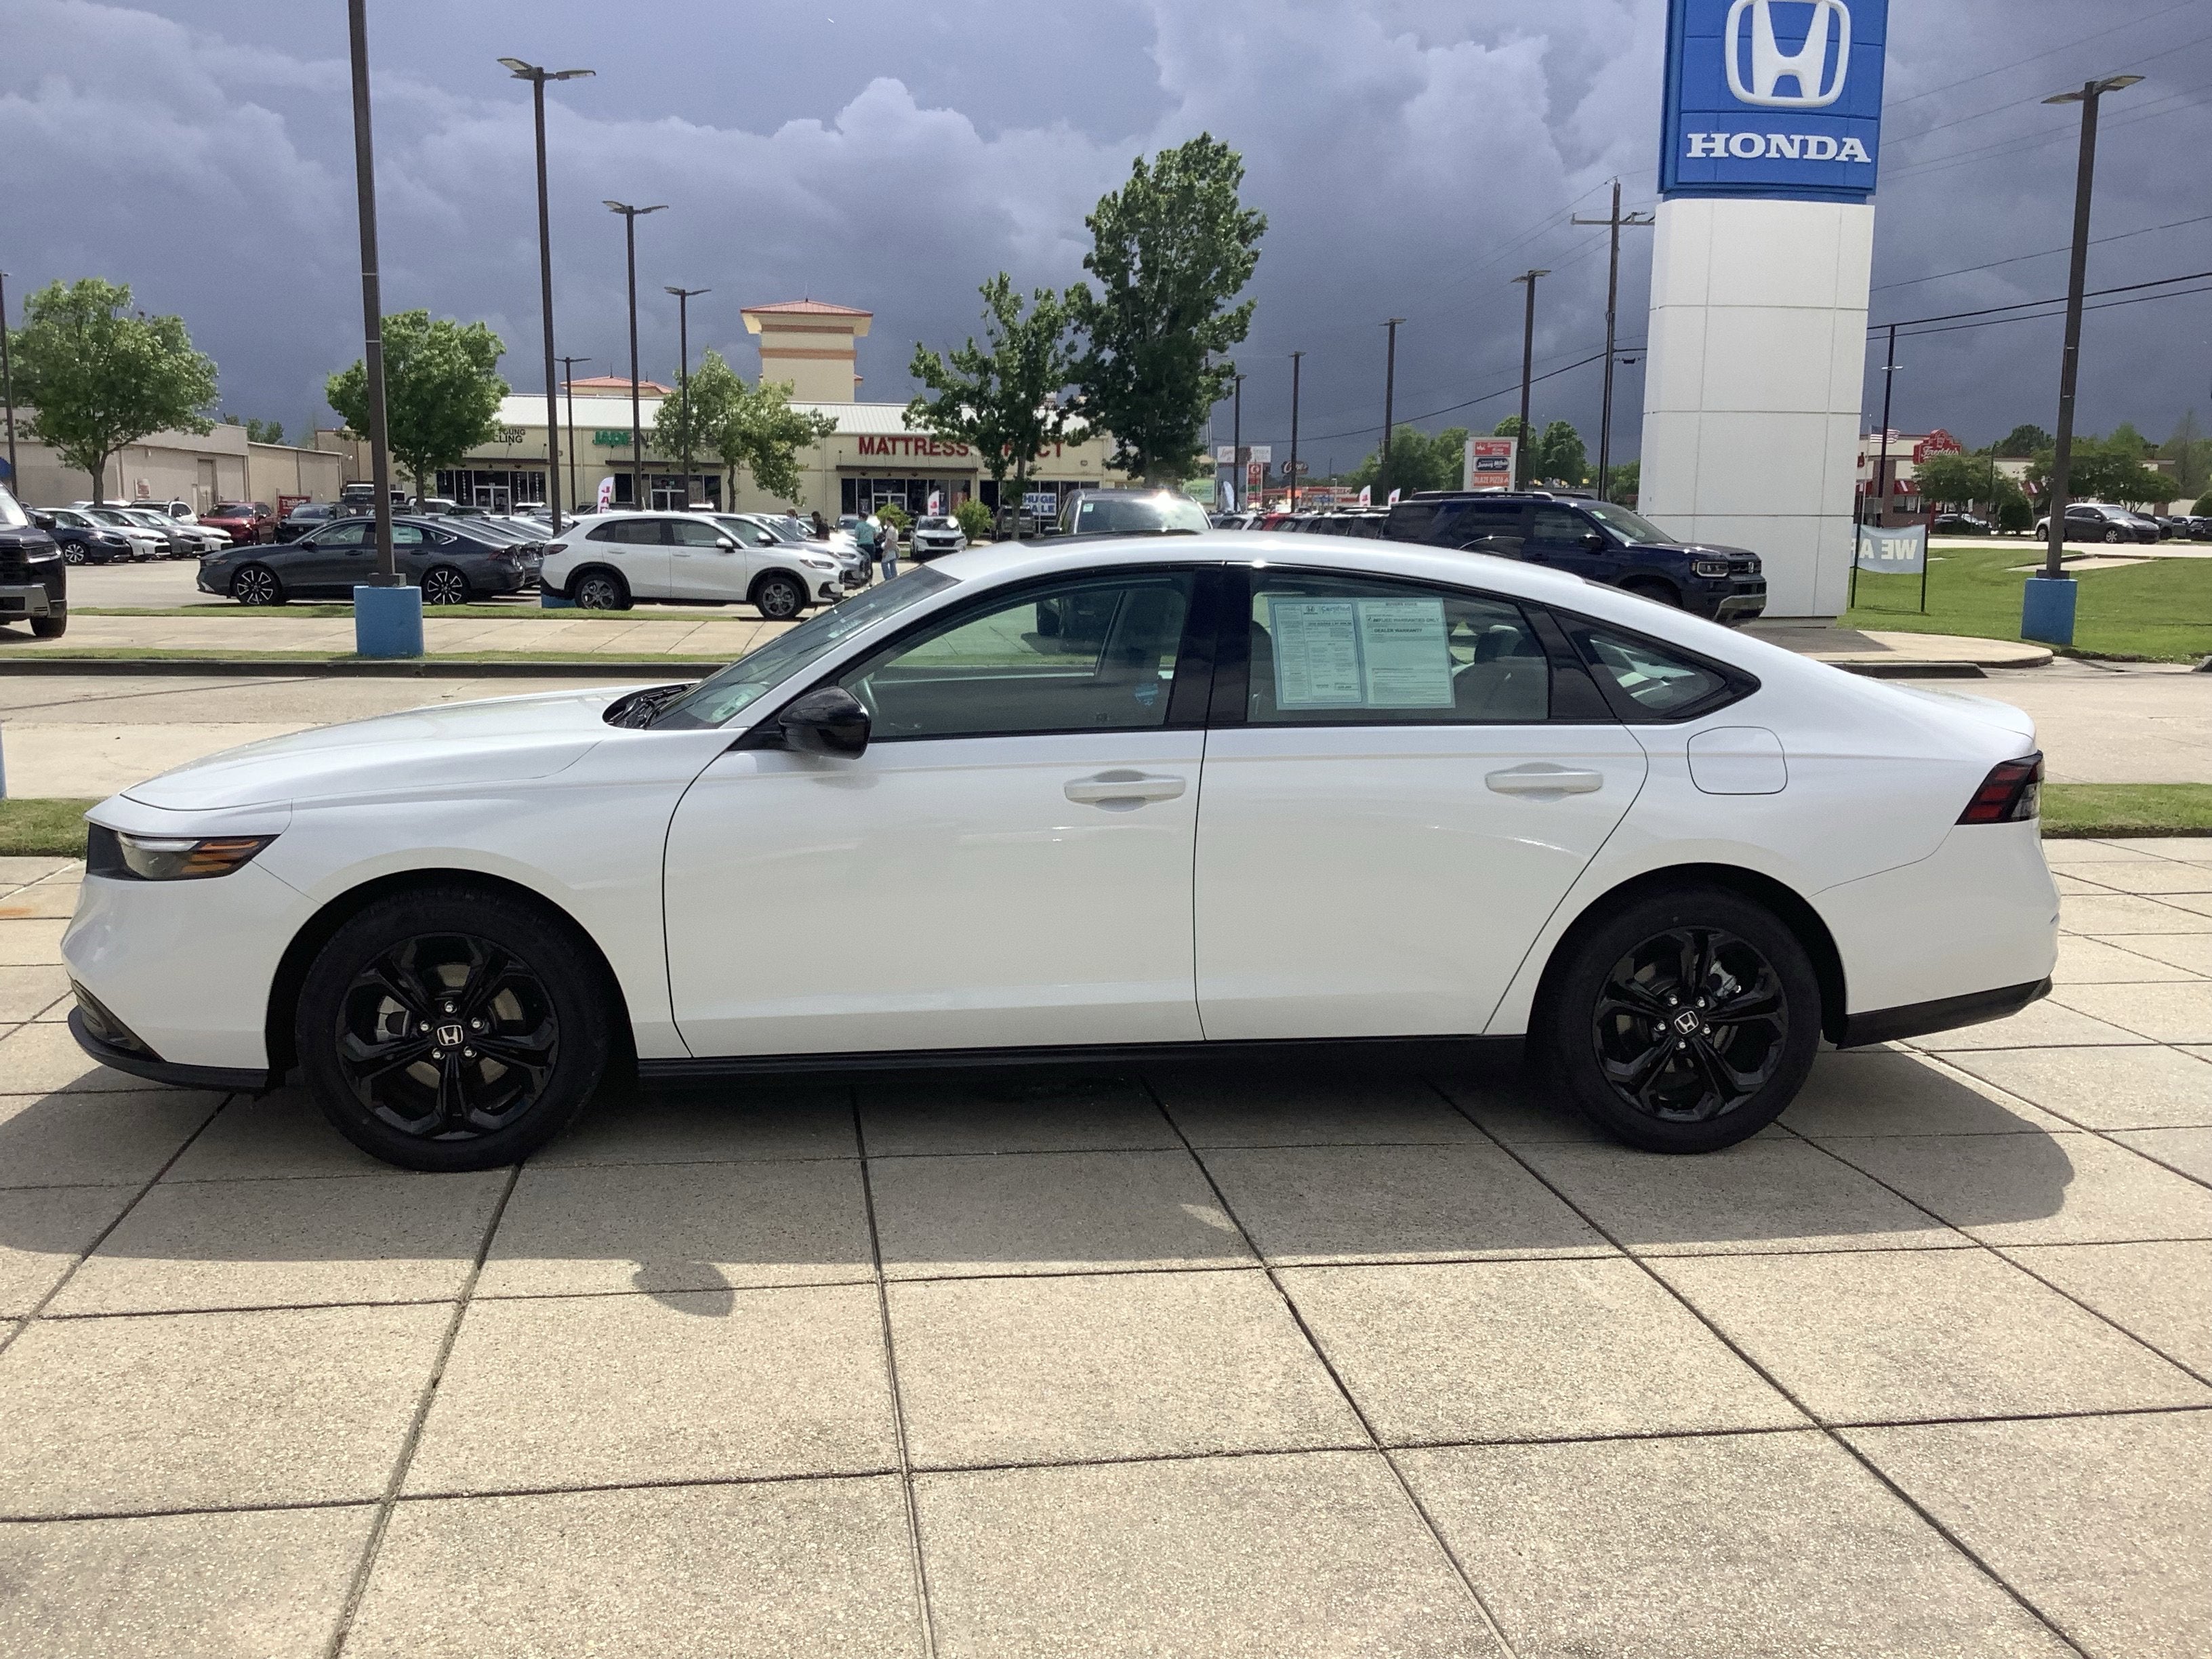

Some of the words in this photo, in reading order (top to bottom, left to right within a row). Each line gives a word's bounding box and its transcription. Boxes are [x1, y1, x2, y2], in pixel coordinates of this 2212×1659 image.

[1686, 131, 1872, 163] HONDA
[858, 436, 969, 457] MATTRESS
[1921, 446, 1959, 459] Freddy's
[1023, 495, 1056, 504] HUGE
[1029, 505, 1055, 513] ALE
